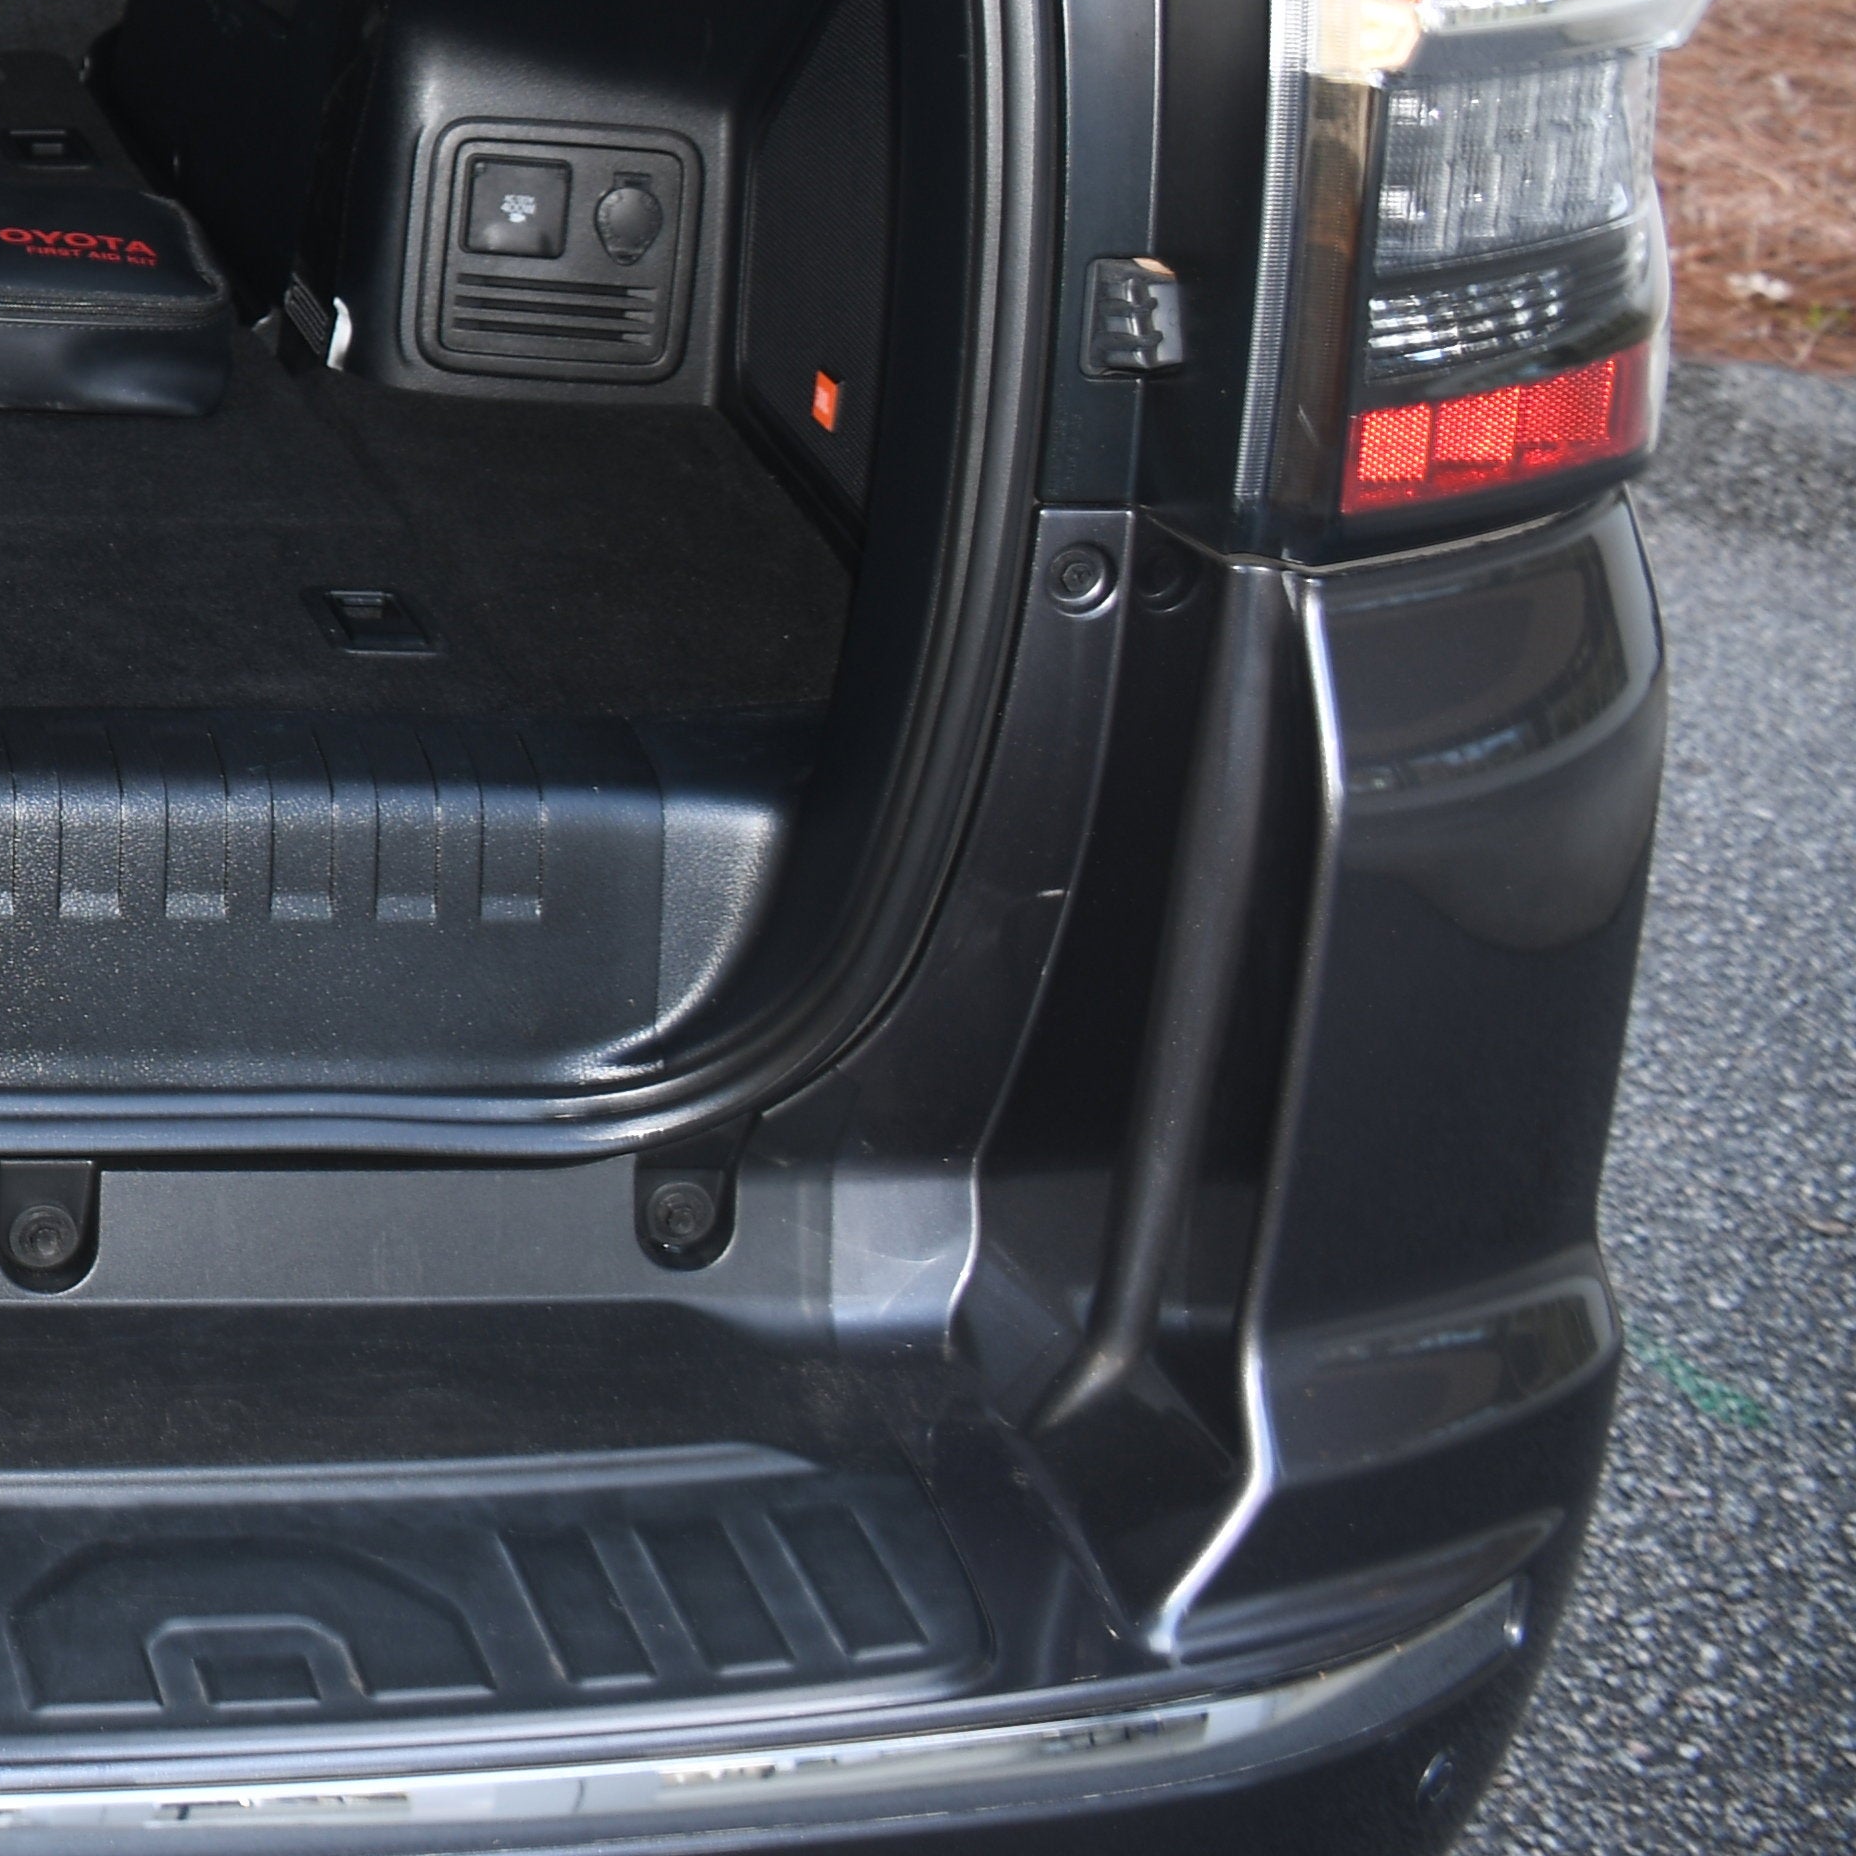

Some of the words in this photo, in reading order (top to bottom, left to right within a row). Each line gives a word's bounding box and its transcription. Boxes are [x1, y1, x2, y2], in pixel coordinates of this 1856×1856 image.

[25, 244, 81, 258] FIRST
[88, 250, 122, 263] AID
[126, 254, 158, 268] KIT
